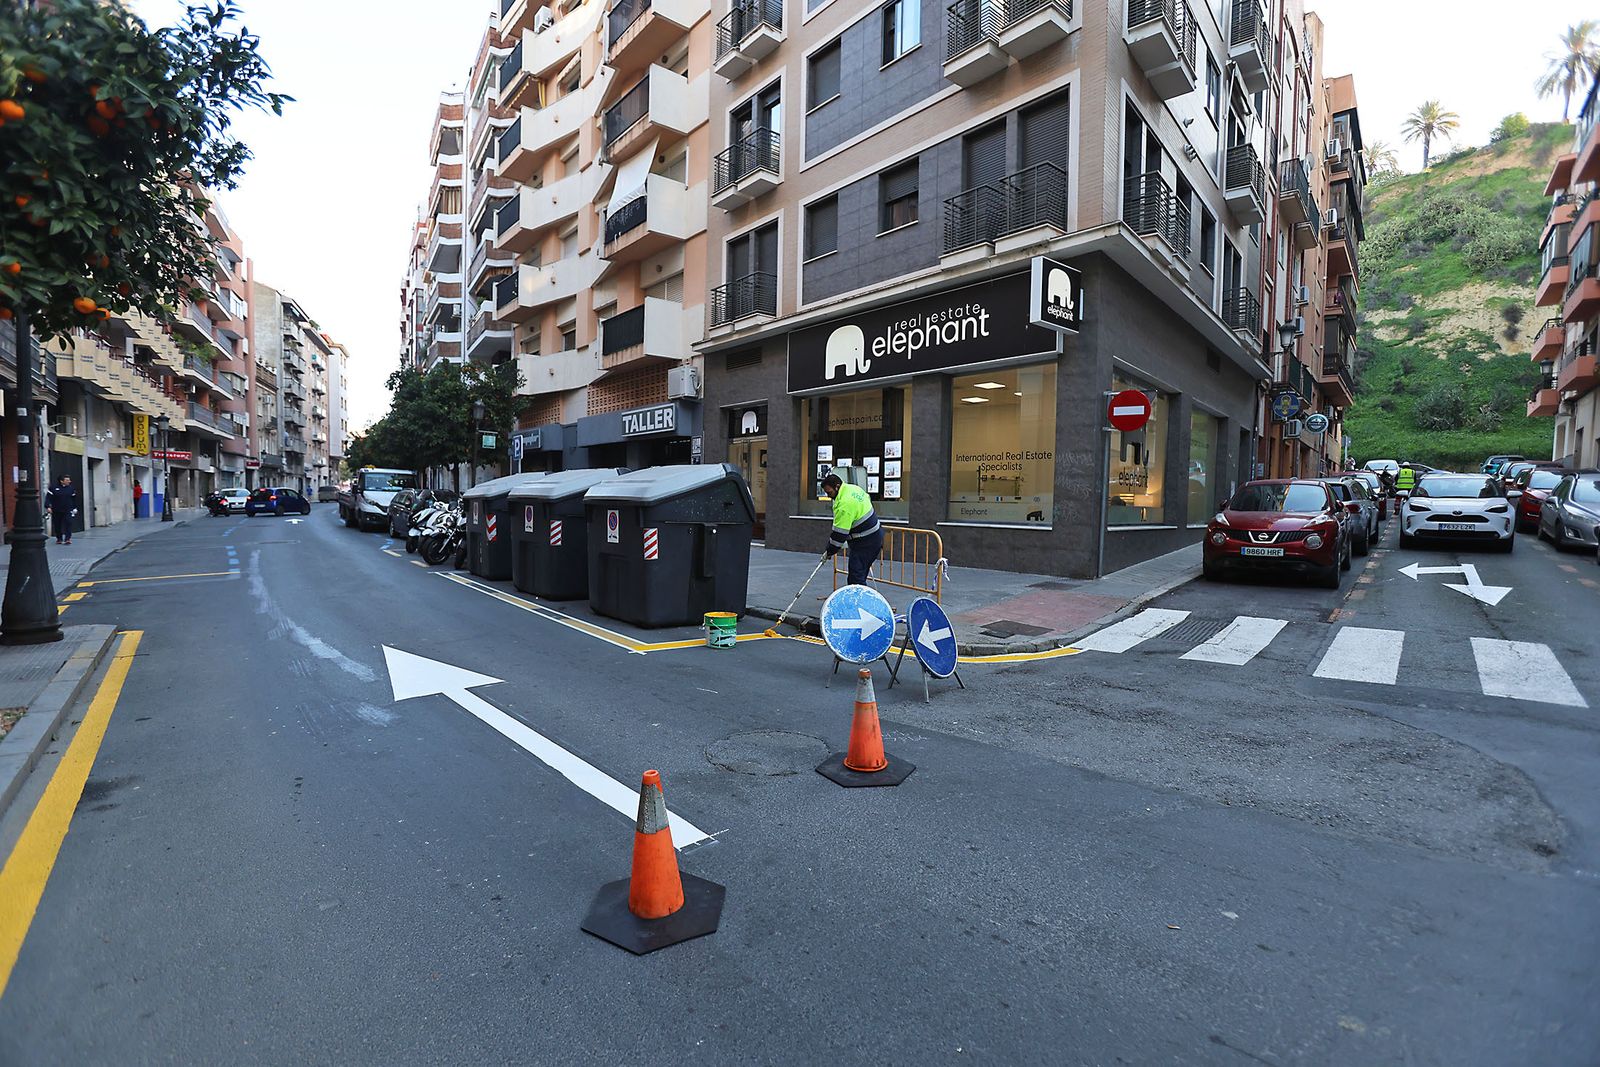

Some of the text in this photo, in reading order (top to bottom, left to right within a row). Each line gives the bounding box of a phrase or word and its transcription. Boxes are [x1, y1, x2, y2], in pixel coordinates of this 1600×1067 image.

[895, 303, 981, 331] real estate
[1047, 304, 1074, 321] elephant
[872, 308, 989, 359] elephant
[622, 408, 673, 433] TALLER
[955, 452, 1004, 462] International
[1005, 451, 1024, 461] Real
[1025, 450, 1053, 460] Estate
[980, 462, 1023, 472] Specialists
[1118, 466, 1149, 491] elephant
[960, 507, 988, 516] Elephant
